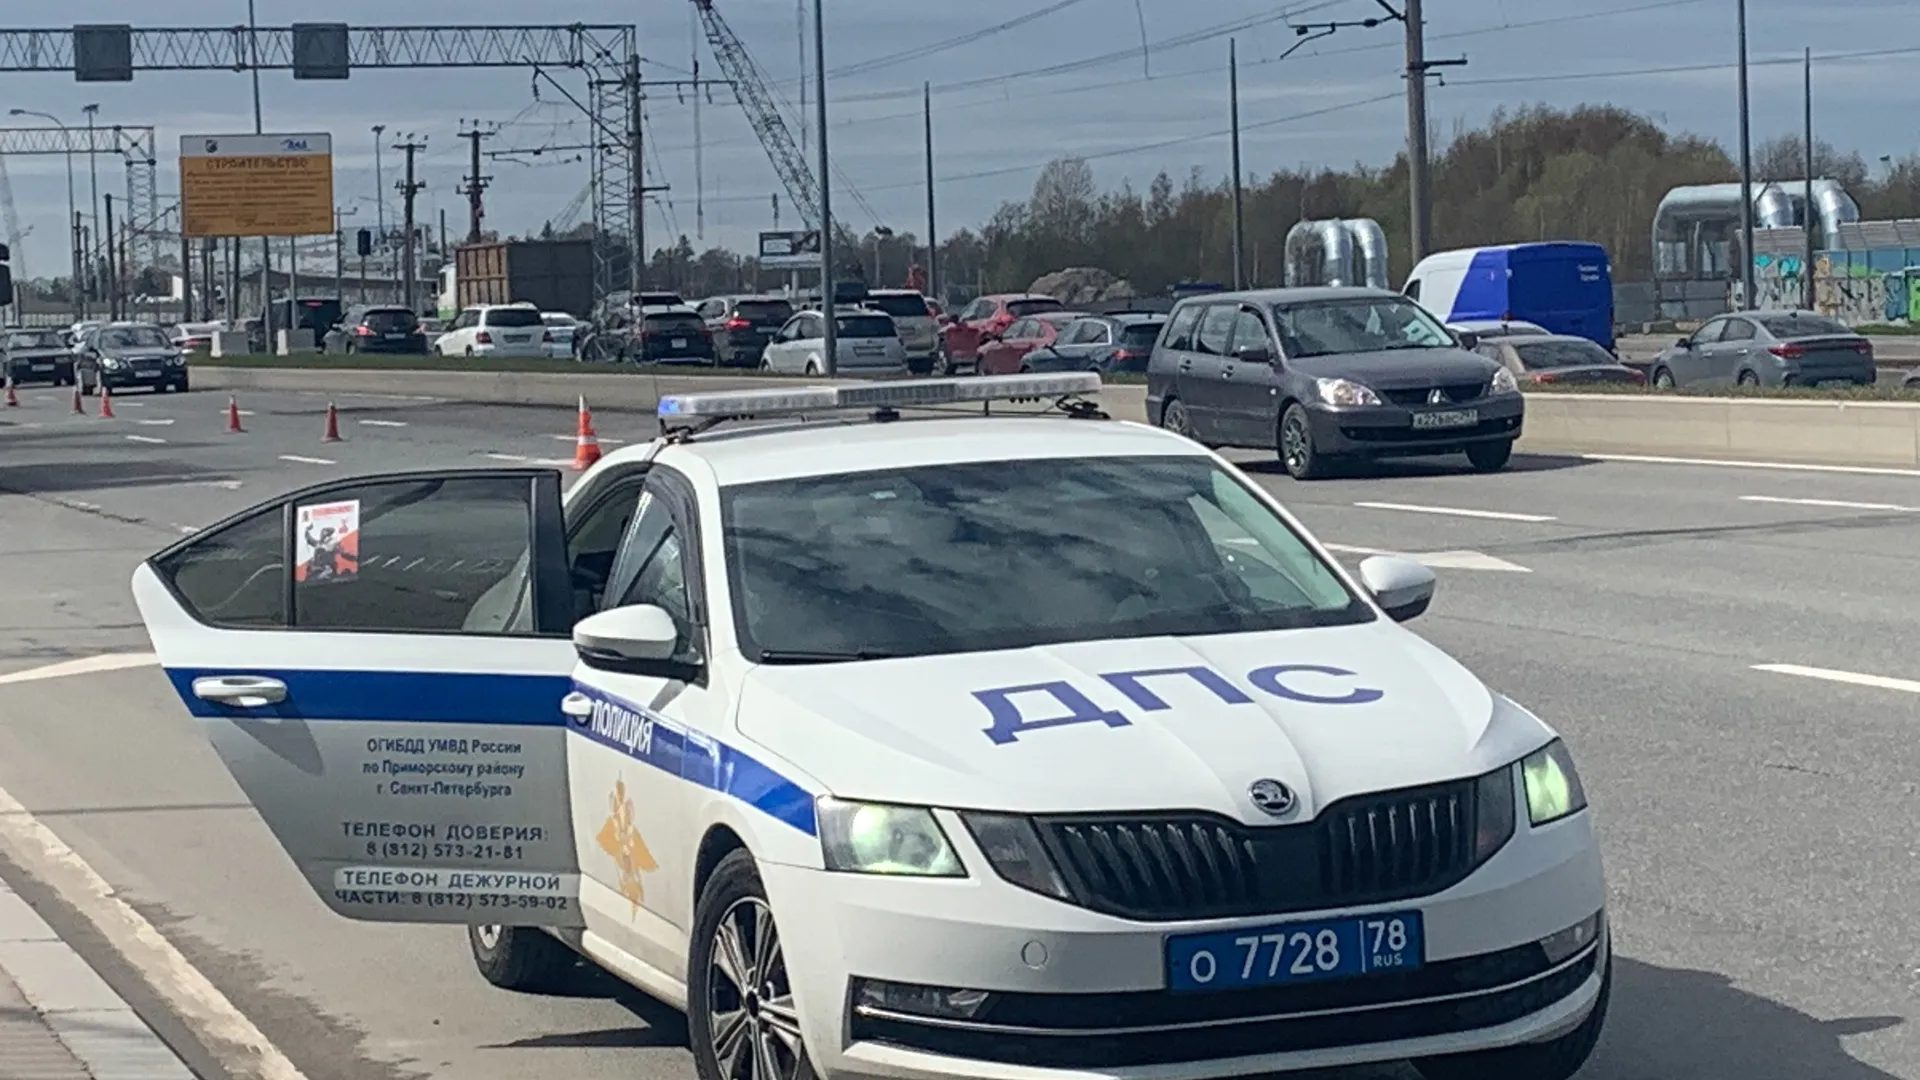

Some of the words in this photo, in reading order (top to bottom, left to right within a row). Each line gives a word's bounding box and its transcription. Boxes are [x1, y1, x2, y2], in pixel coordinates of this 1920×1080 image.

[970, 663, 1384, 746] ДПС
[591, 698, 654, 755] ПОЛИЦИЯ
[366, 738, 425, 754] ОГИБДД
[428, 738, 468, 754] УМВД
[471, 739, 522, 754] России
[363, 762, 379, 774] по
[382, 759, 473, 777] Приморскому
[477, 760, 525, 778] району
[390, 781, 512, 798] Санкт-Петербурга
[341, 822, 436, 838] ТЕЛЕФОН
[445, 824, 549, 842] ДОВЕРИЯ:
[366, 843, 377, 856] 8
[382, 843, 428, 859] (812)
[434, 844, 523, 859] 573-21-81
[343, 871, 438, 886] ТЕЛЕФОН
[448, 873, 560, 891] ДЕЖУРНОЙ
[335, 890, 406, 906] ЧАСТИ:
[412, 892, 422, 905] 8
[427, 892, 473, 909] (812)
[479, 893, 568, 910] 573-59-02
[1367, 918, 1407, 953] 78
[1235, 928, 1340, 980] 7728
[1373, 952, 1403, 968] RUS
